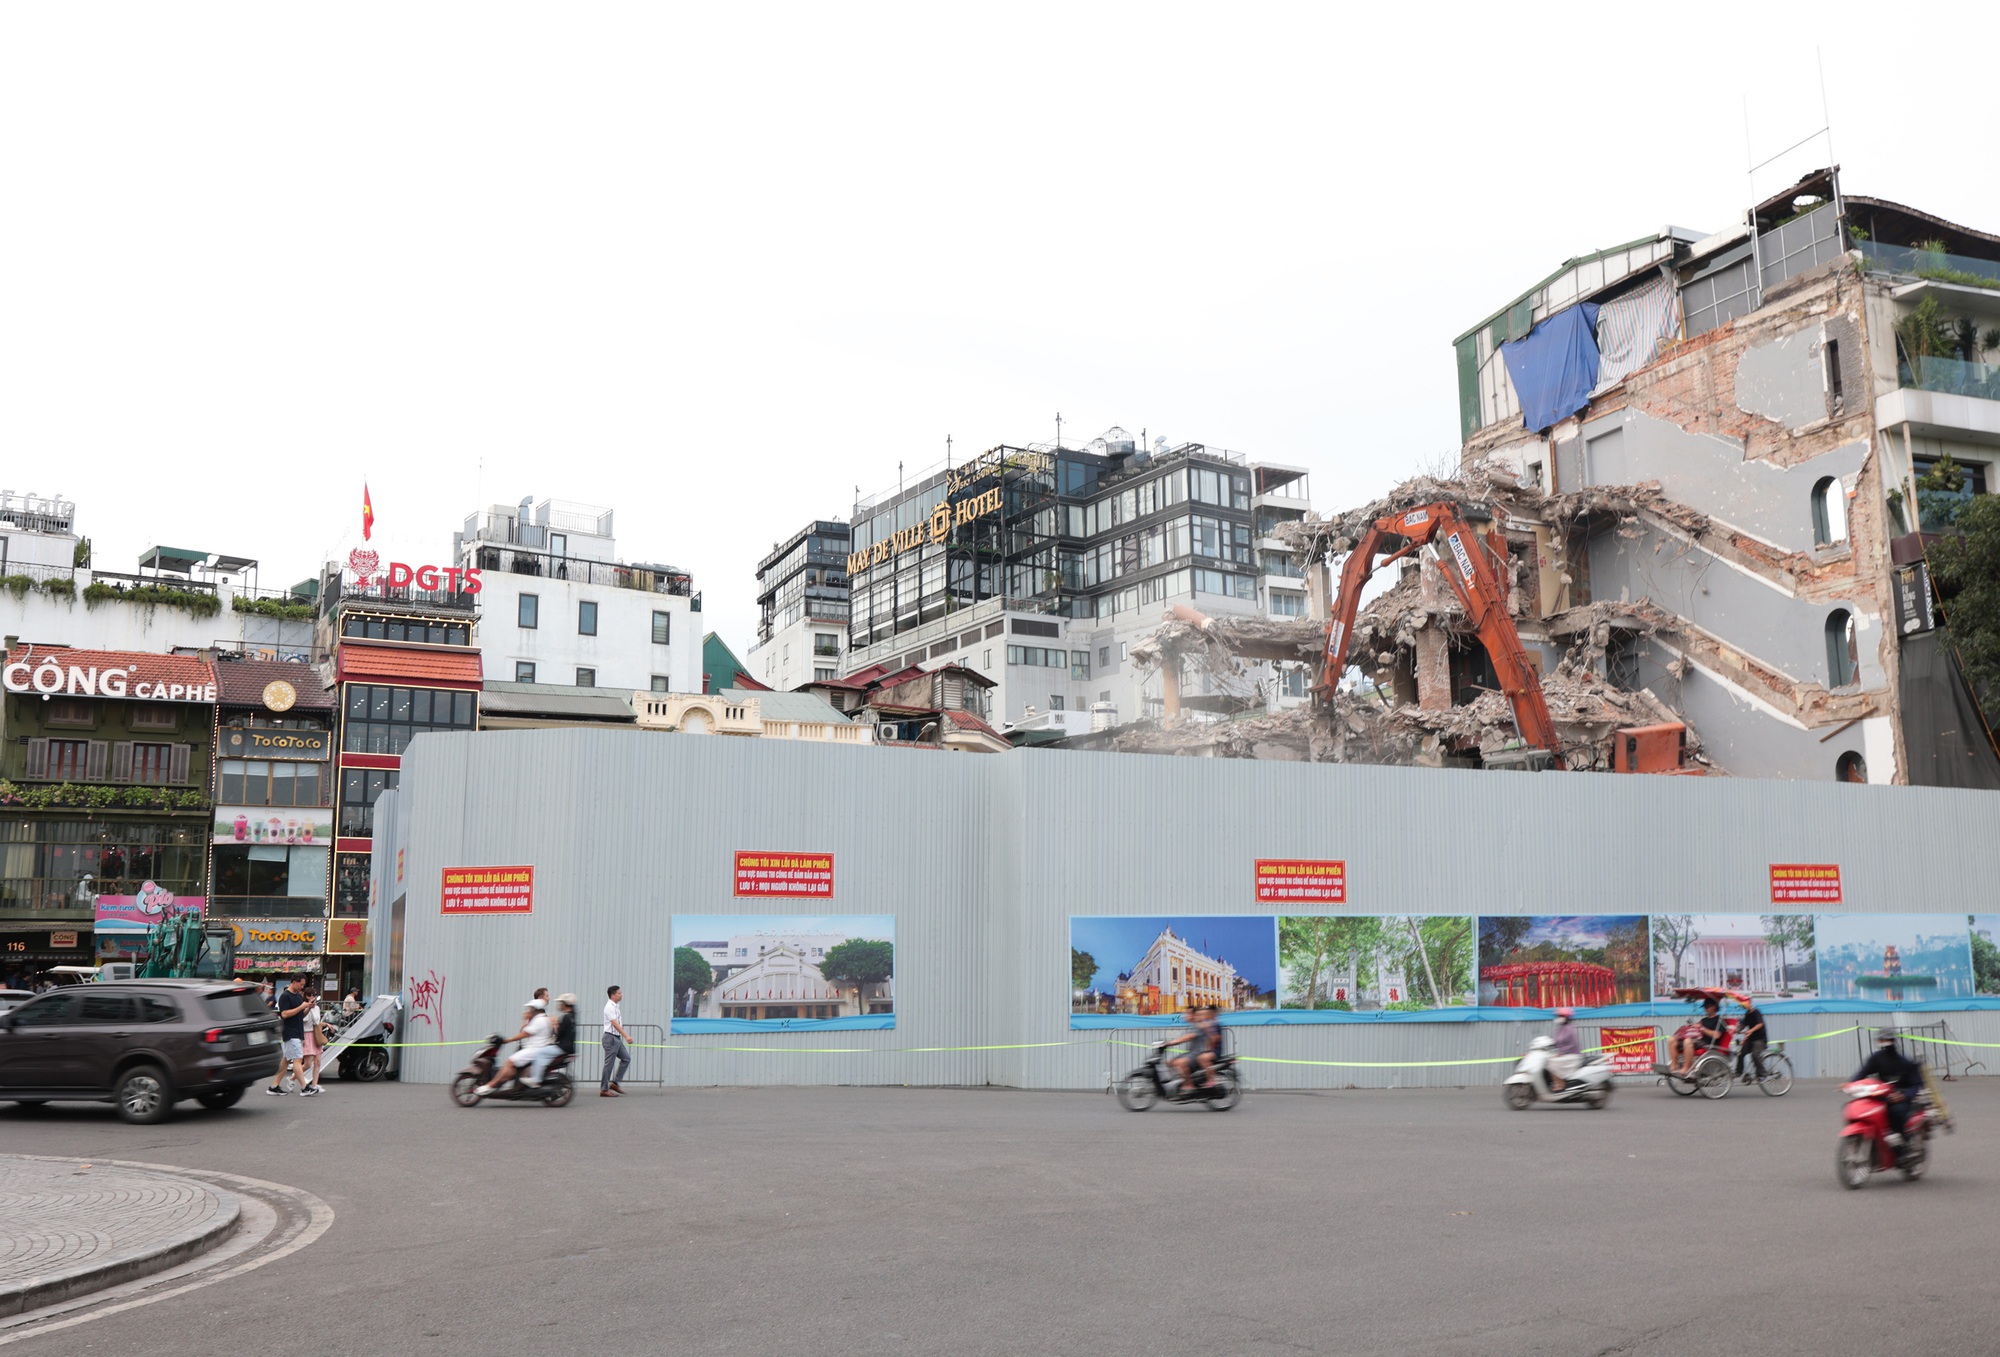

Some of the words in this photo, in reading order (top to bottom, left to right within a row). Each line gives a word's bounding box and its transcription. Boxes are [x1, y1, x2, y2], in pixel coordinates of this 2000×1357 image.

[846, 548, 871, 577] MAY
[873, 537, 889, 565] DE
[892, 522, 925, 555] VILLE
[956, 487, 1003, 527] HOTEL
[1453, 543, 1465, 560] BAC
[1460, 558, 1473, 577] NAM
[388, 562, 482, 594] DGTS
[3, 656, 128, 701] CỘNG
[7, 942, 26, 951] 116
